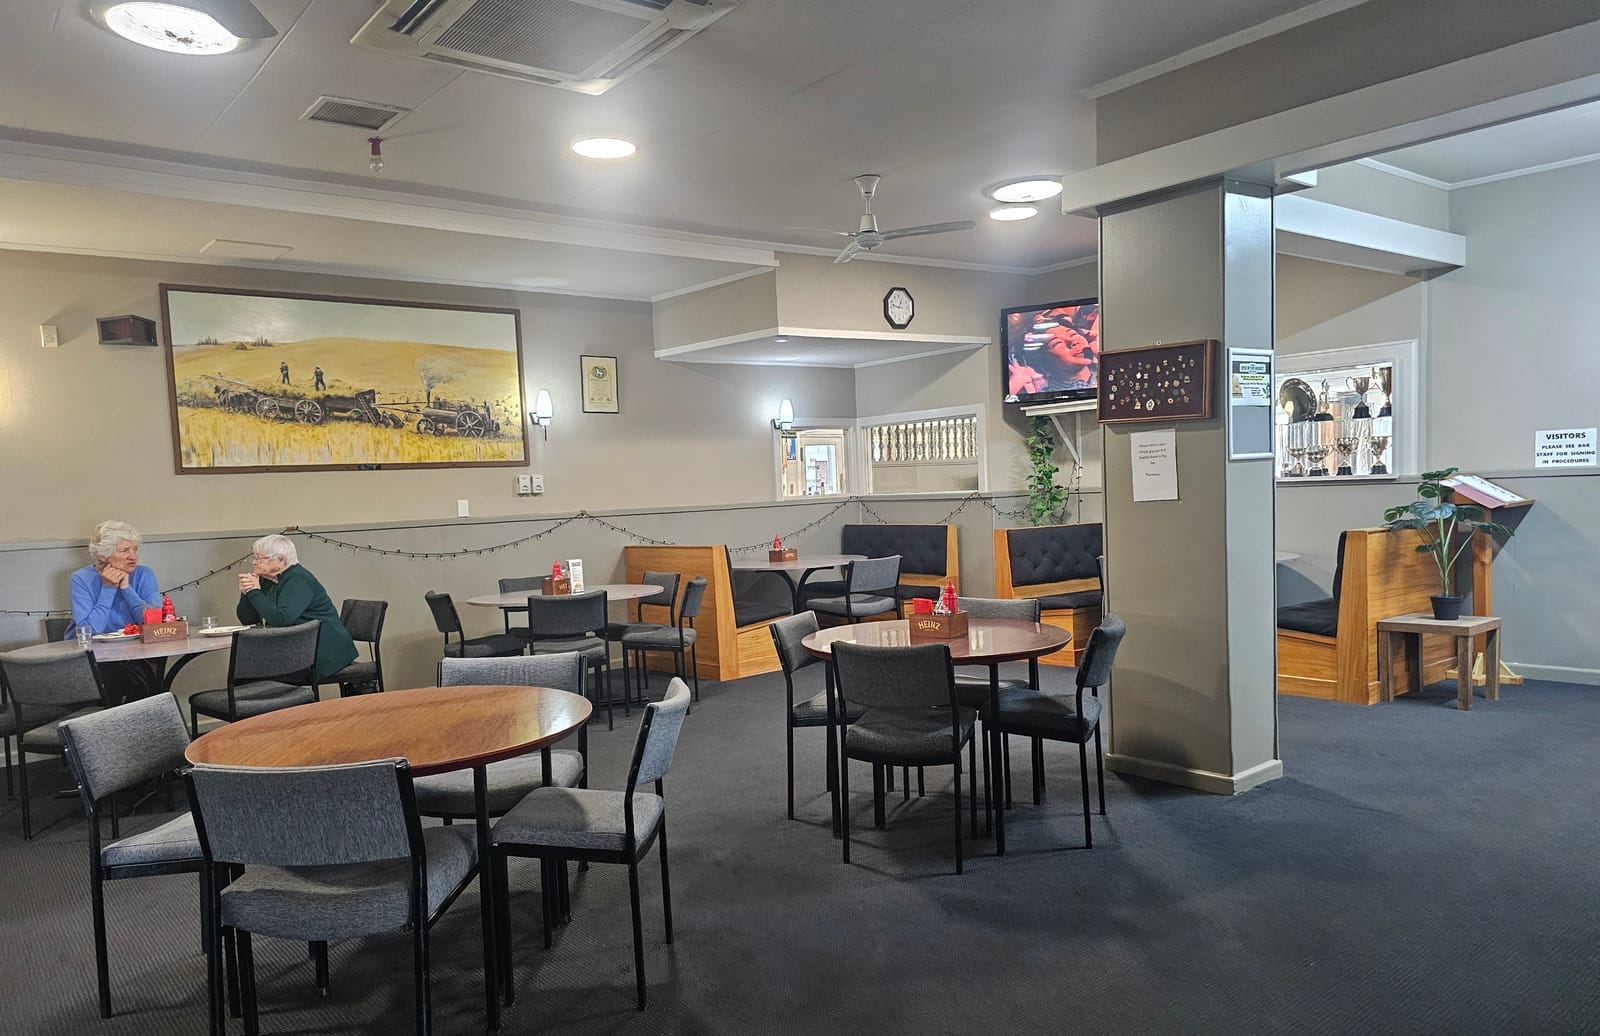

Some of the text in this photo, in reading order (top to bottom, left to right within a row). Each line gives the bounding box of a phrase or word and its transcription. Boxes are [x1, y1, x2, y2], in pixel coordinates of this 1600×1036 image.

[1545, 432, 1586, 440] VISITORS
[918, 620, 941, 630] HEINZ
[153, 627, 177, 637] HEINZ
